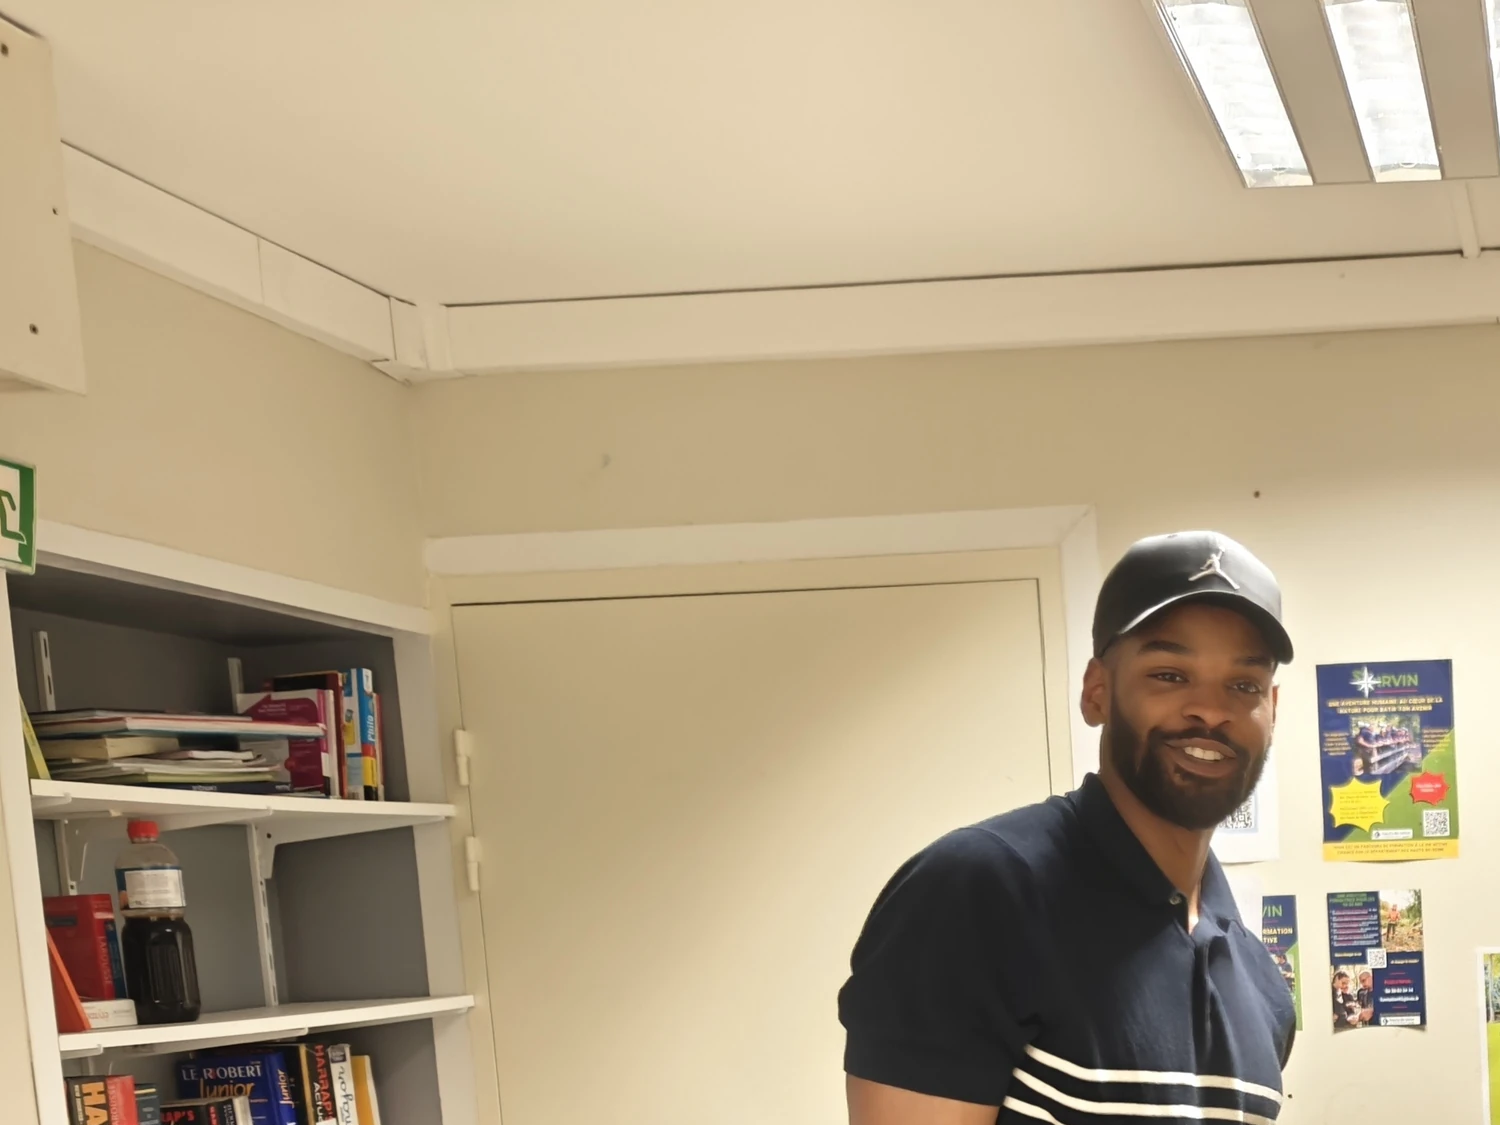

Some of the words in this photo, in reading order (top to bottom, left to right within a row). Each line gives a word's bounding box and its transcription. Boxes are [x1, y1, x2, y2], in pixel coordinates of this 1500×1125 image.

[367, 714, 376, 742] Philo
[181, 1066, 199, 1081] LE
[203, 1064, 263, 1081] ROBERT
[200, 1077, 255, 1100] Junior
[277, 1069, 295, 1109] Junior
